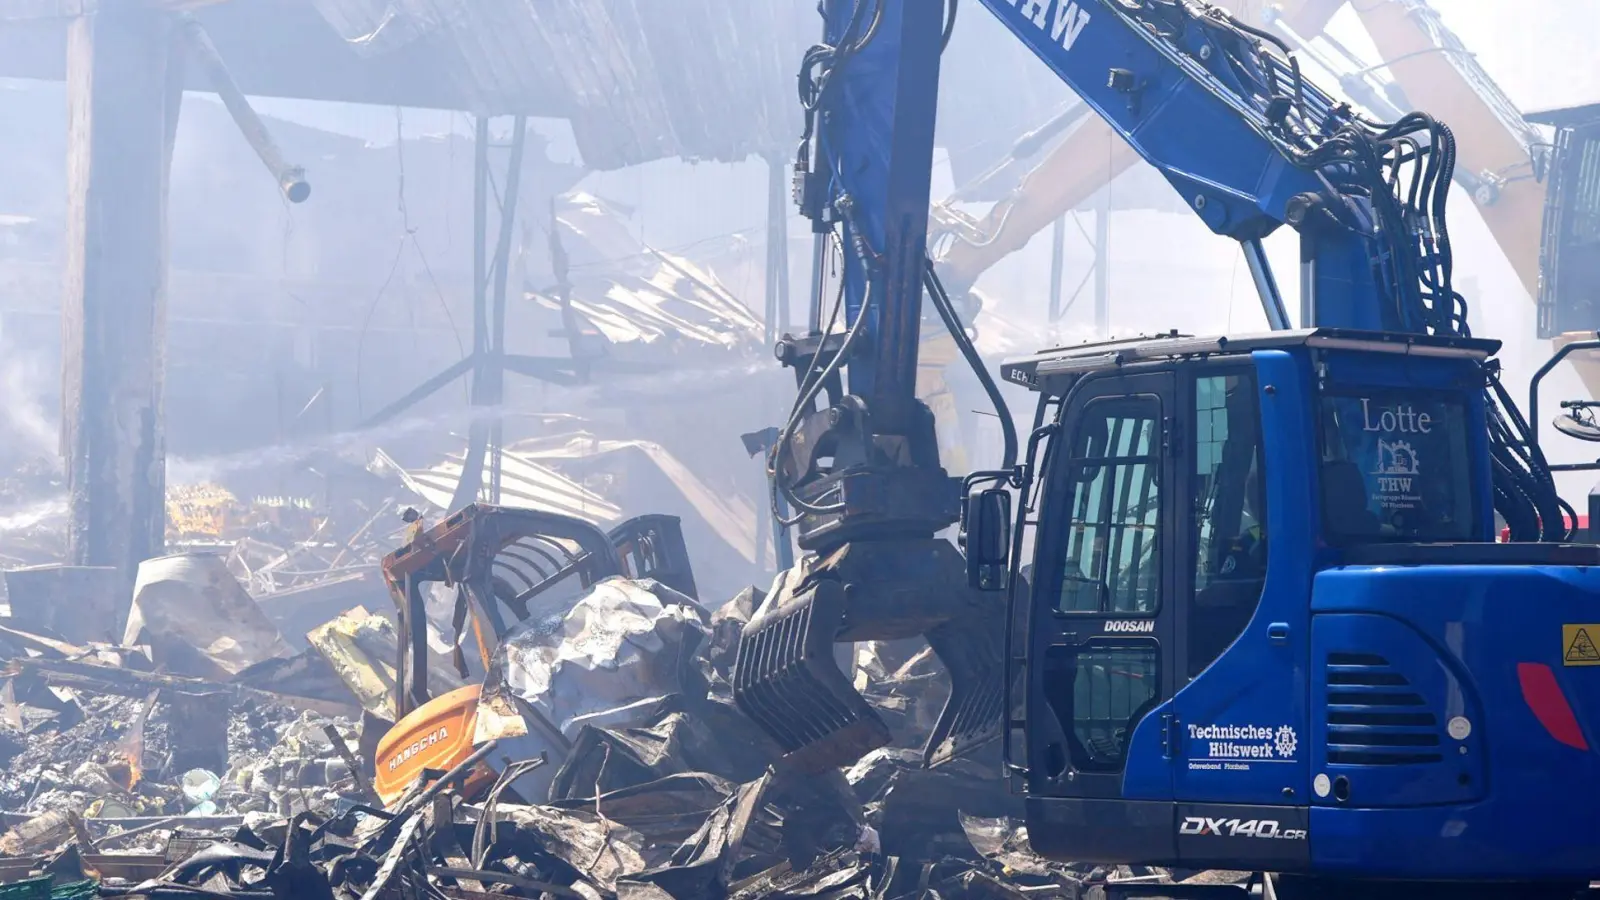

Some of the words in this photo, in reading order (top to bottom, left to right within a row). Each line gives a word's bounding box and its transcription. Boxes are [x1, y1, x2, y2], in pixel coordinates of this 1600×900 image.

[1006, 0, 1091, 51] HW
[1360, 398, 1431, 433] Lotte
[1377, 477, 1412, 492] THW
[1104, 620, 1155, 632] DOOSAN
[1188, 724, 1273, 740] Technisches
[389, 726, 448, 772] HANGCHA
[1209, 742, 1273, 758] Hilfswerk
